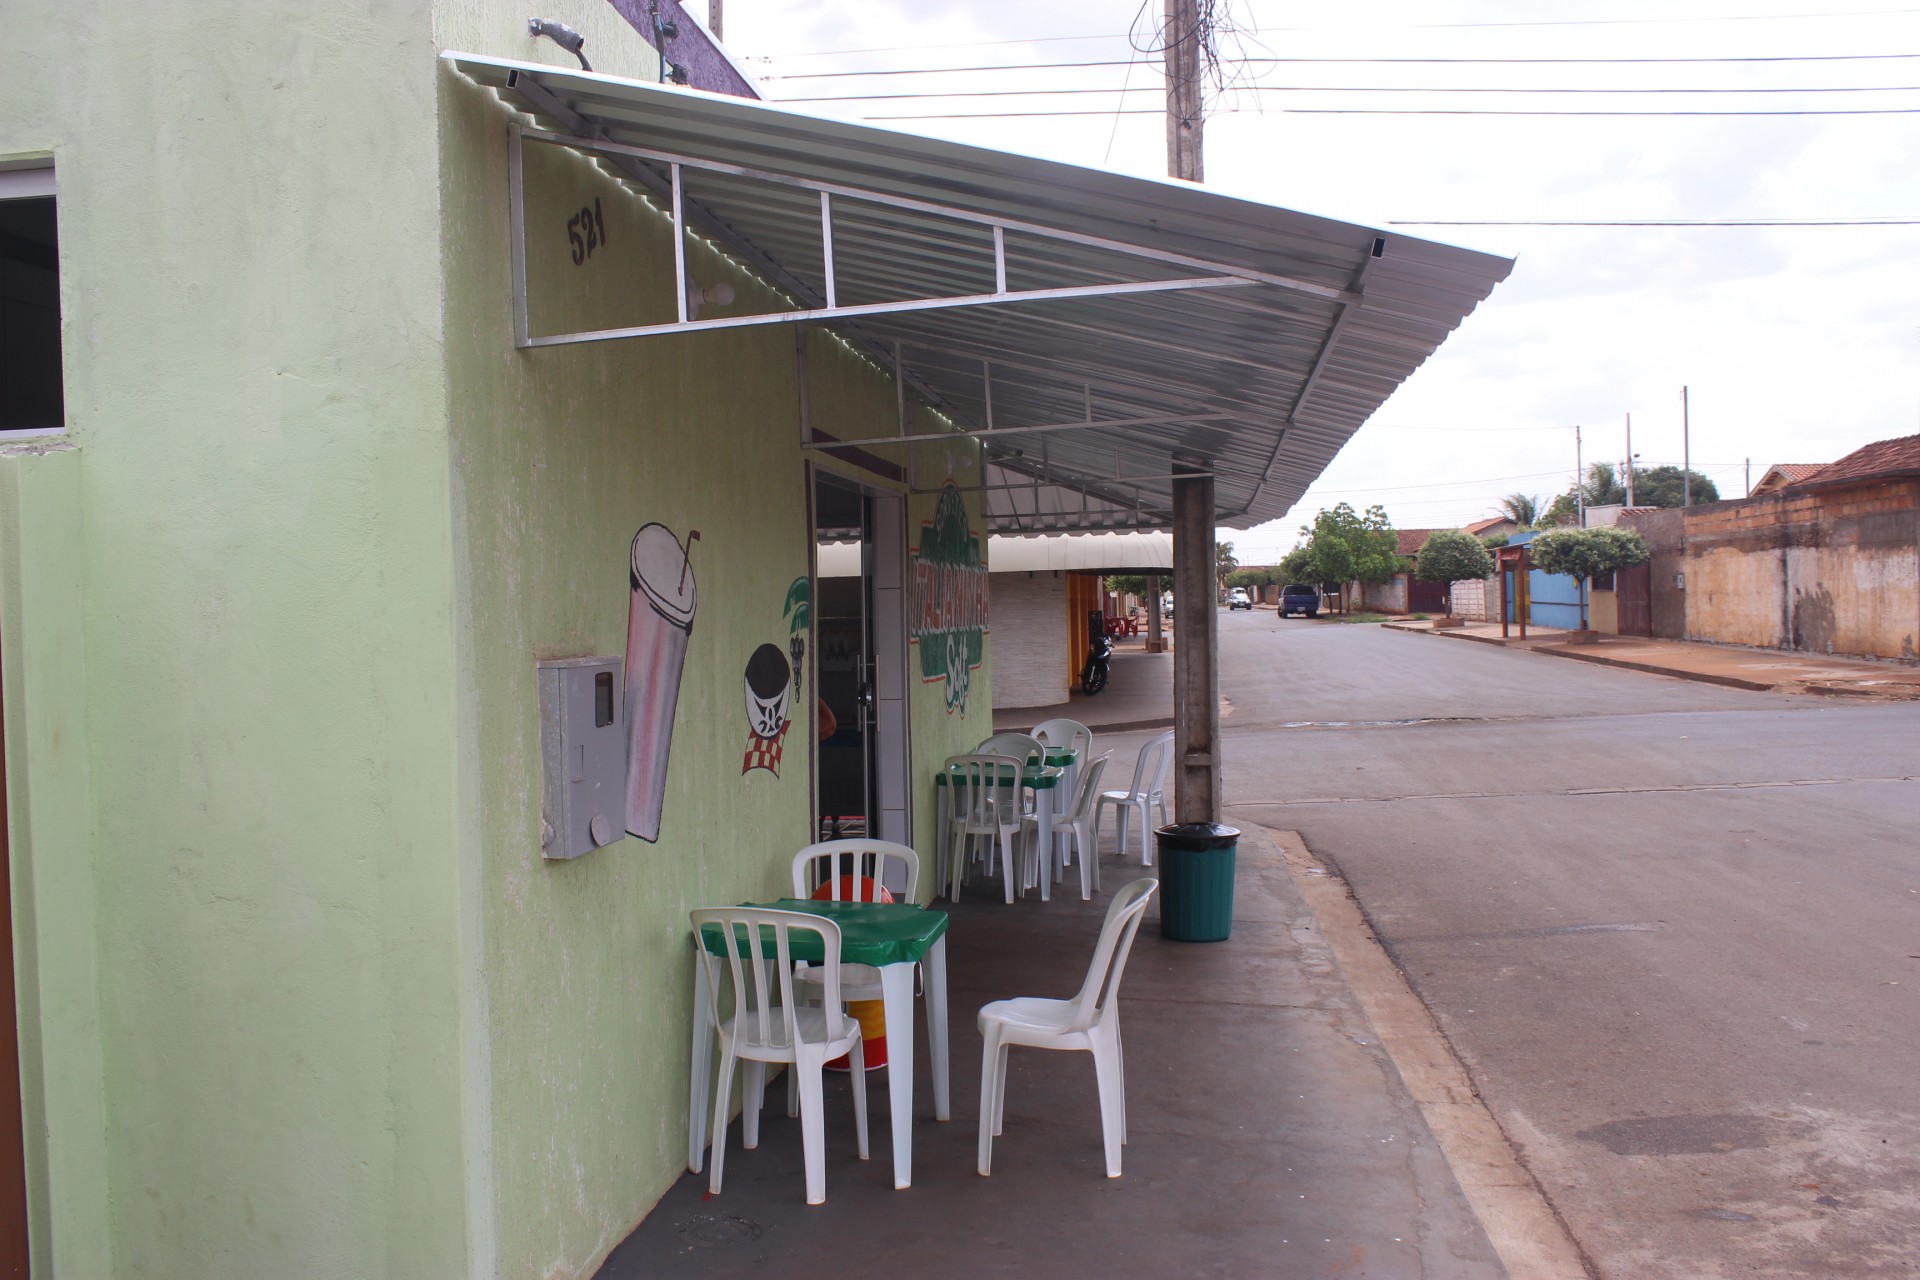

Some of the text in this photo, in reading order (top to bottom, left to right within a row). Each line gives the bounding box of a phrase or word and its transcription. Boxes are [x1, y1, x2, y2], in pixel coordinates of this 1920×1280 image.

[567, 196, 606, 267] 521
[911, 557, 989, 635] ITALIANINHA
[946, 633, 968, 707] Soft
